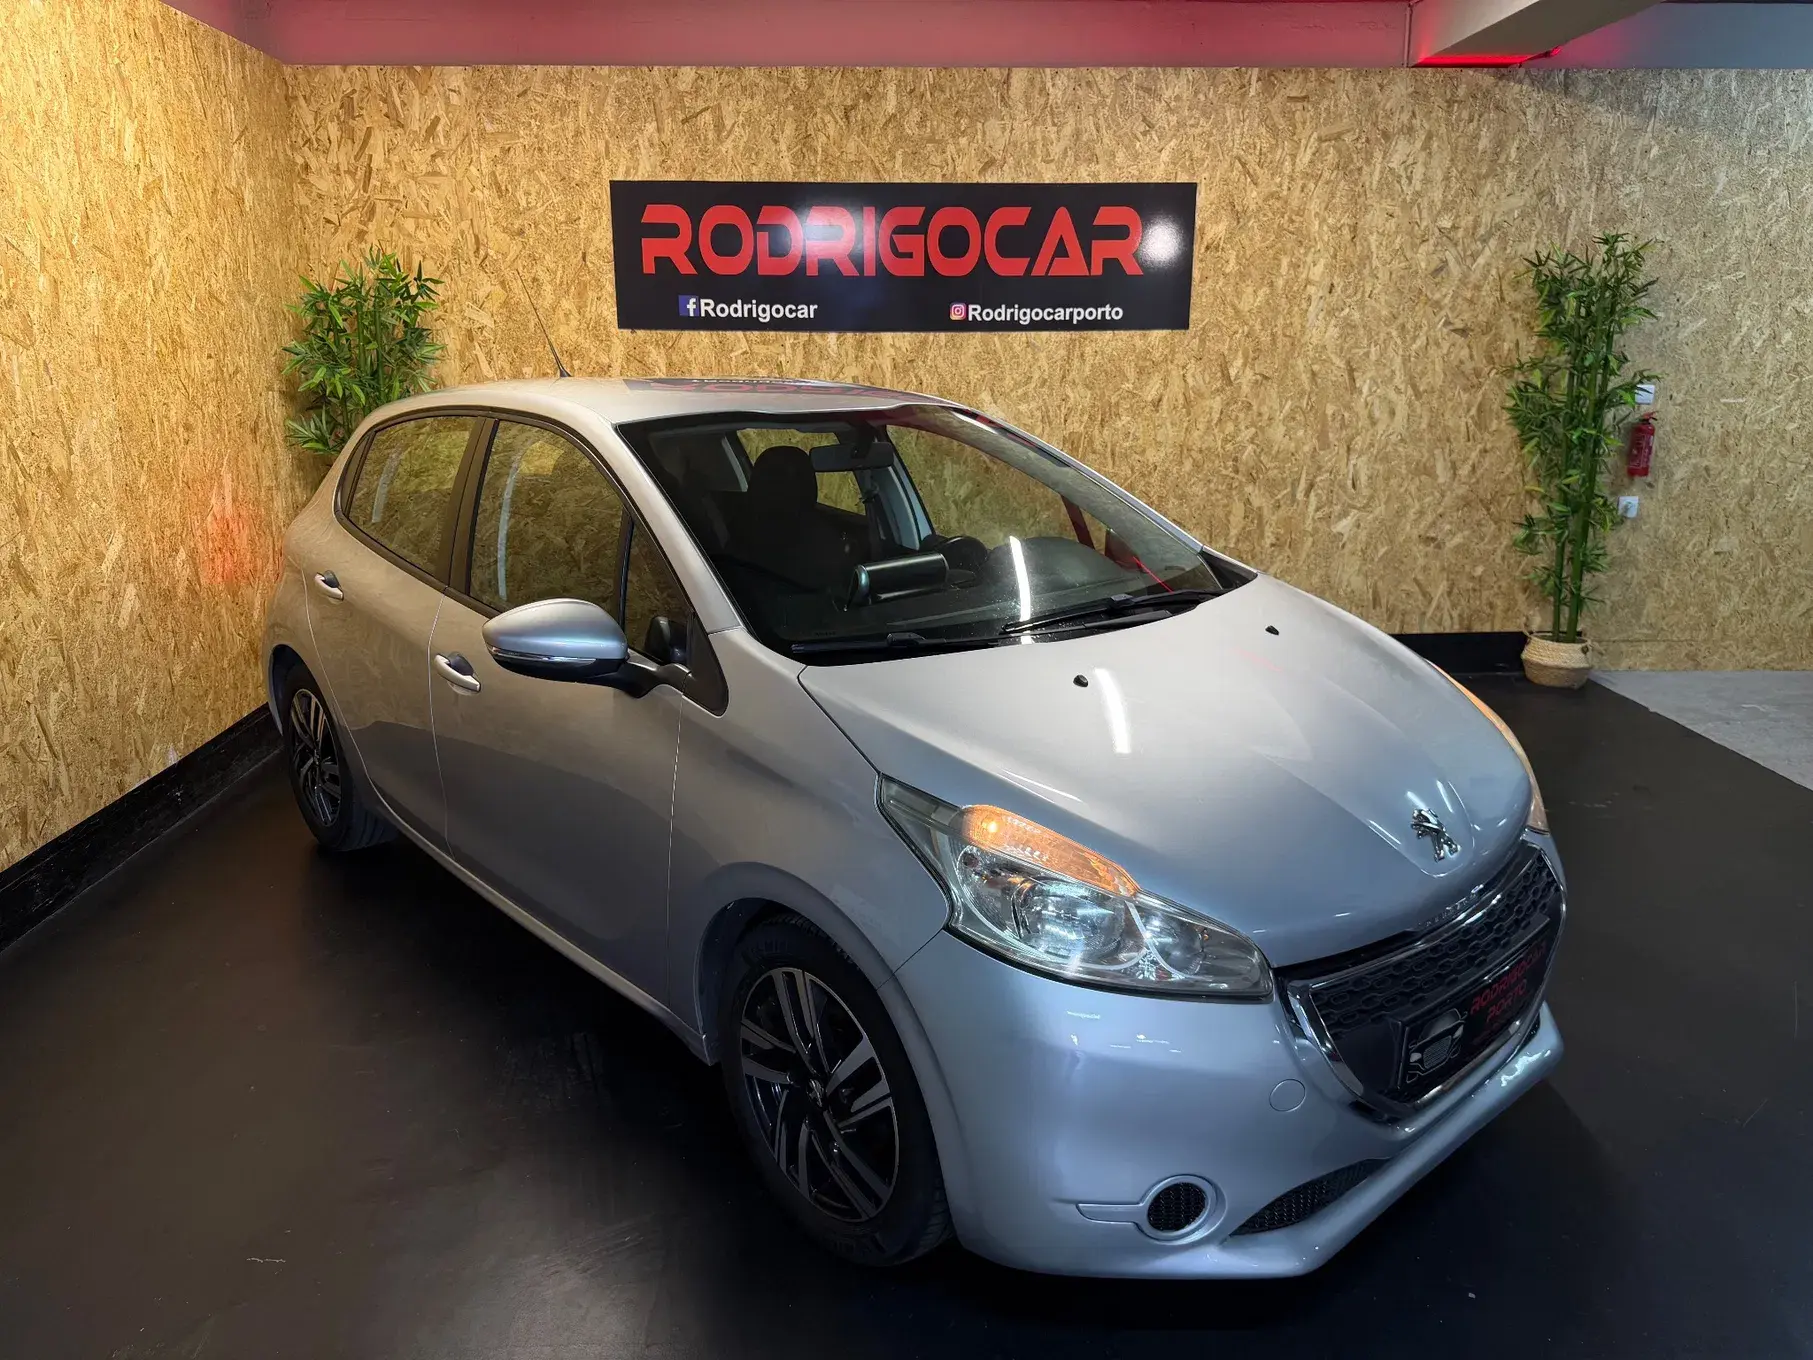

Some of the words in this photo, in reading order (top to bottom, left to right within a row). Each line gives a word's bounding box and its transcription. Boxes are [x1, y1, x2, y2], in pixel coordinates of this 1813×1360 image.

[641, 203, 1144, 277] RODRIGOCAR
[700, 298, 818, 323] Rodrigocar
[968, 303, 1124, 325] Rodrigocarporto
